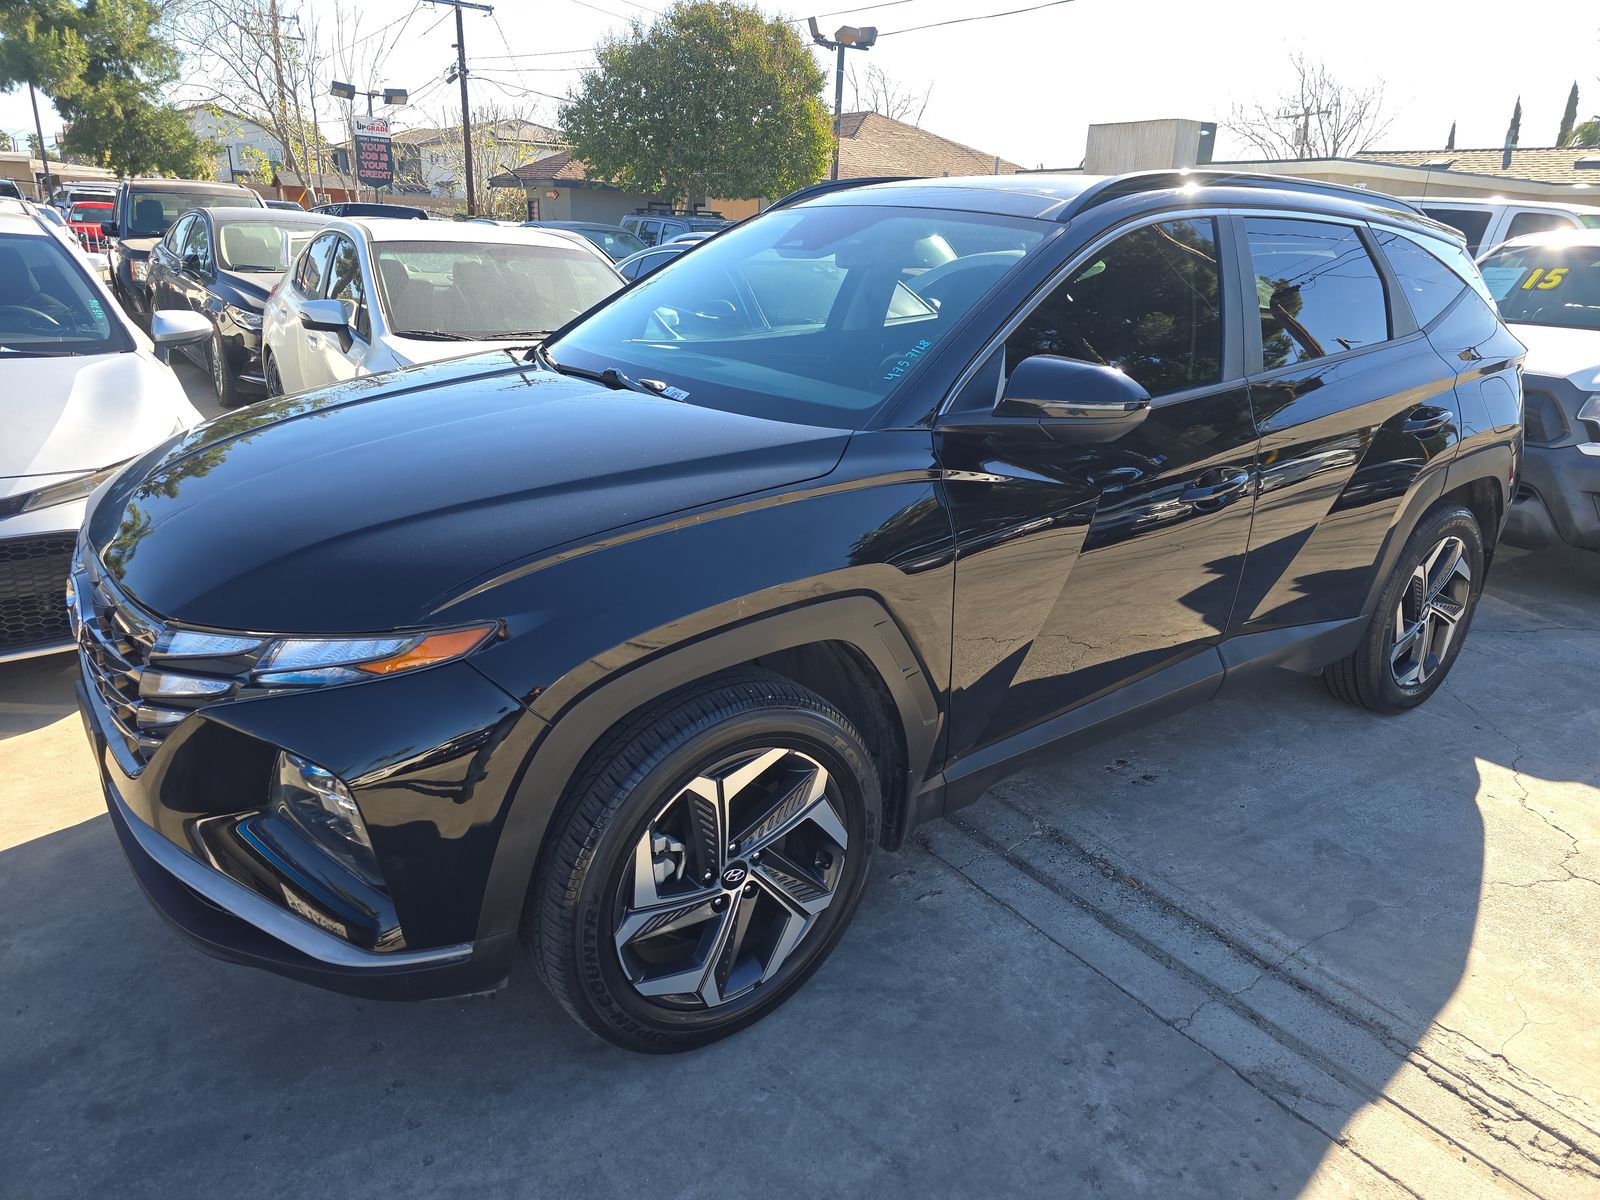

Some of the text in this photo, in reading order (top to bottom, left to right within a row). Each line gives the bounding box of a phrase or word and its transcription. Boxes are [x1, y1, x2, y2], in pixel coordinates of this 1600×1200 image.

[356, 120, 389, 132] UPGRADE
[361, 142, 387, 152] YOUR
[360, 151, 389, 161] JOB IS
[361, 160, 388, 170] YOUR
[359, 169, 392, 179] CREDIT
[1522, 268, 1569, 290] 15
